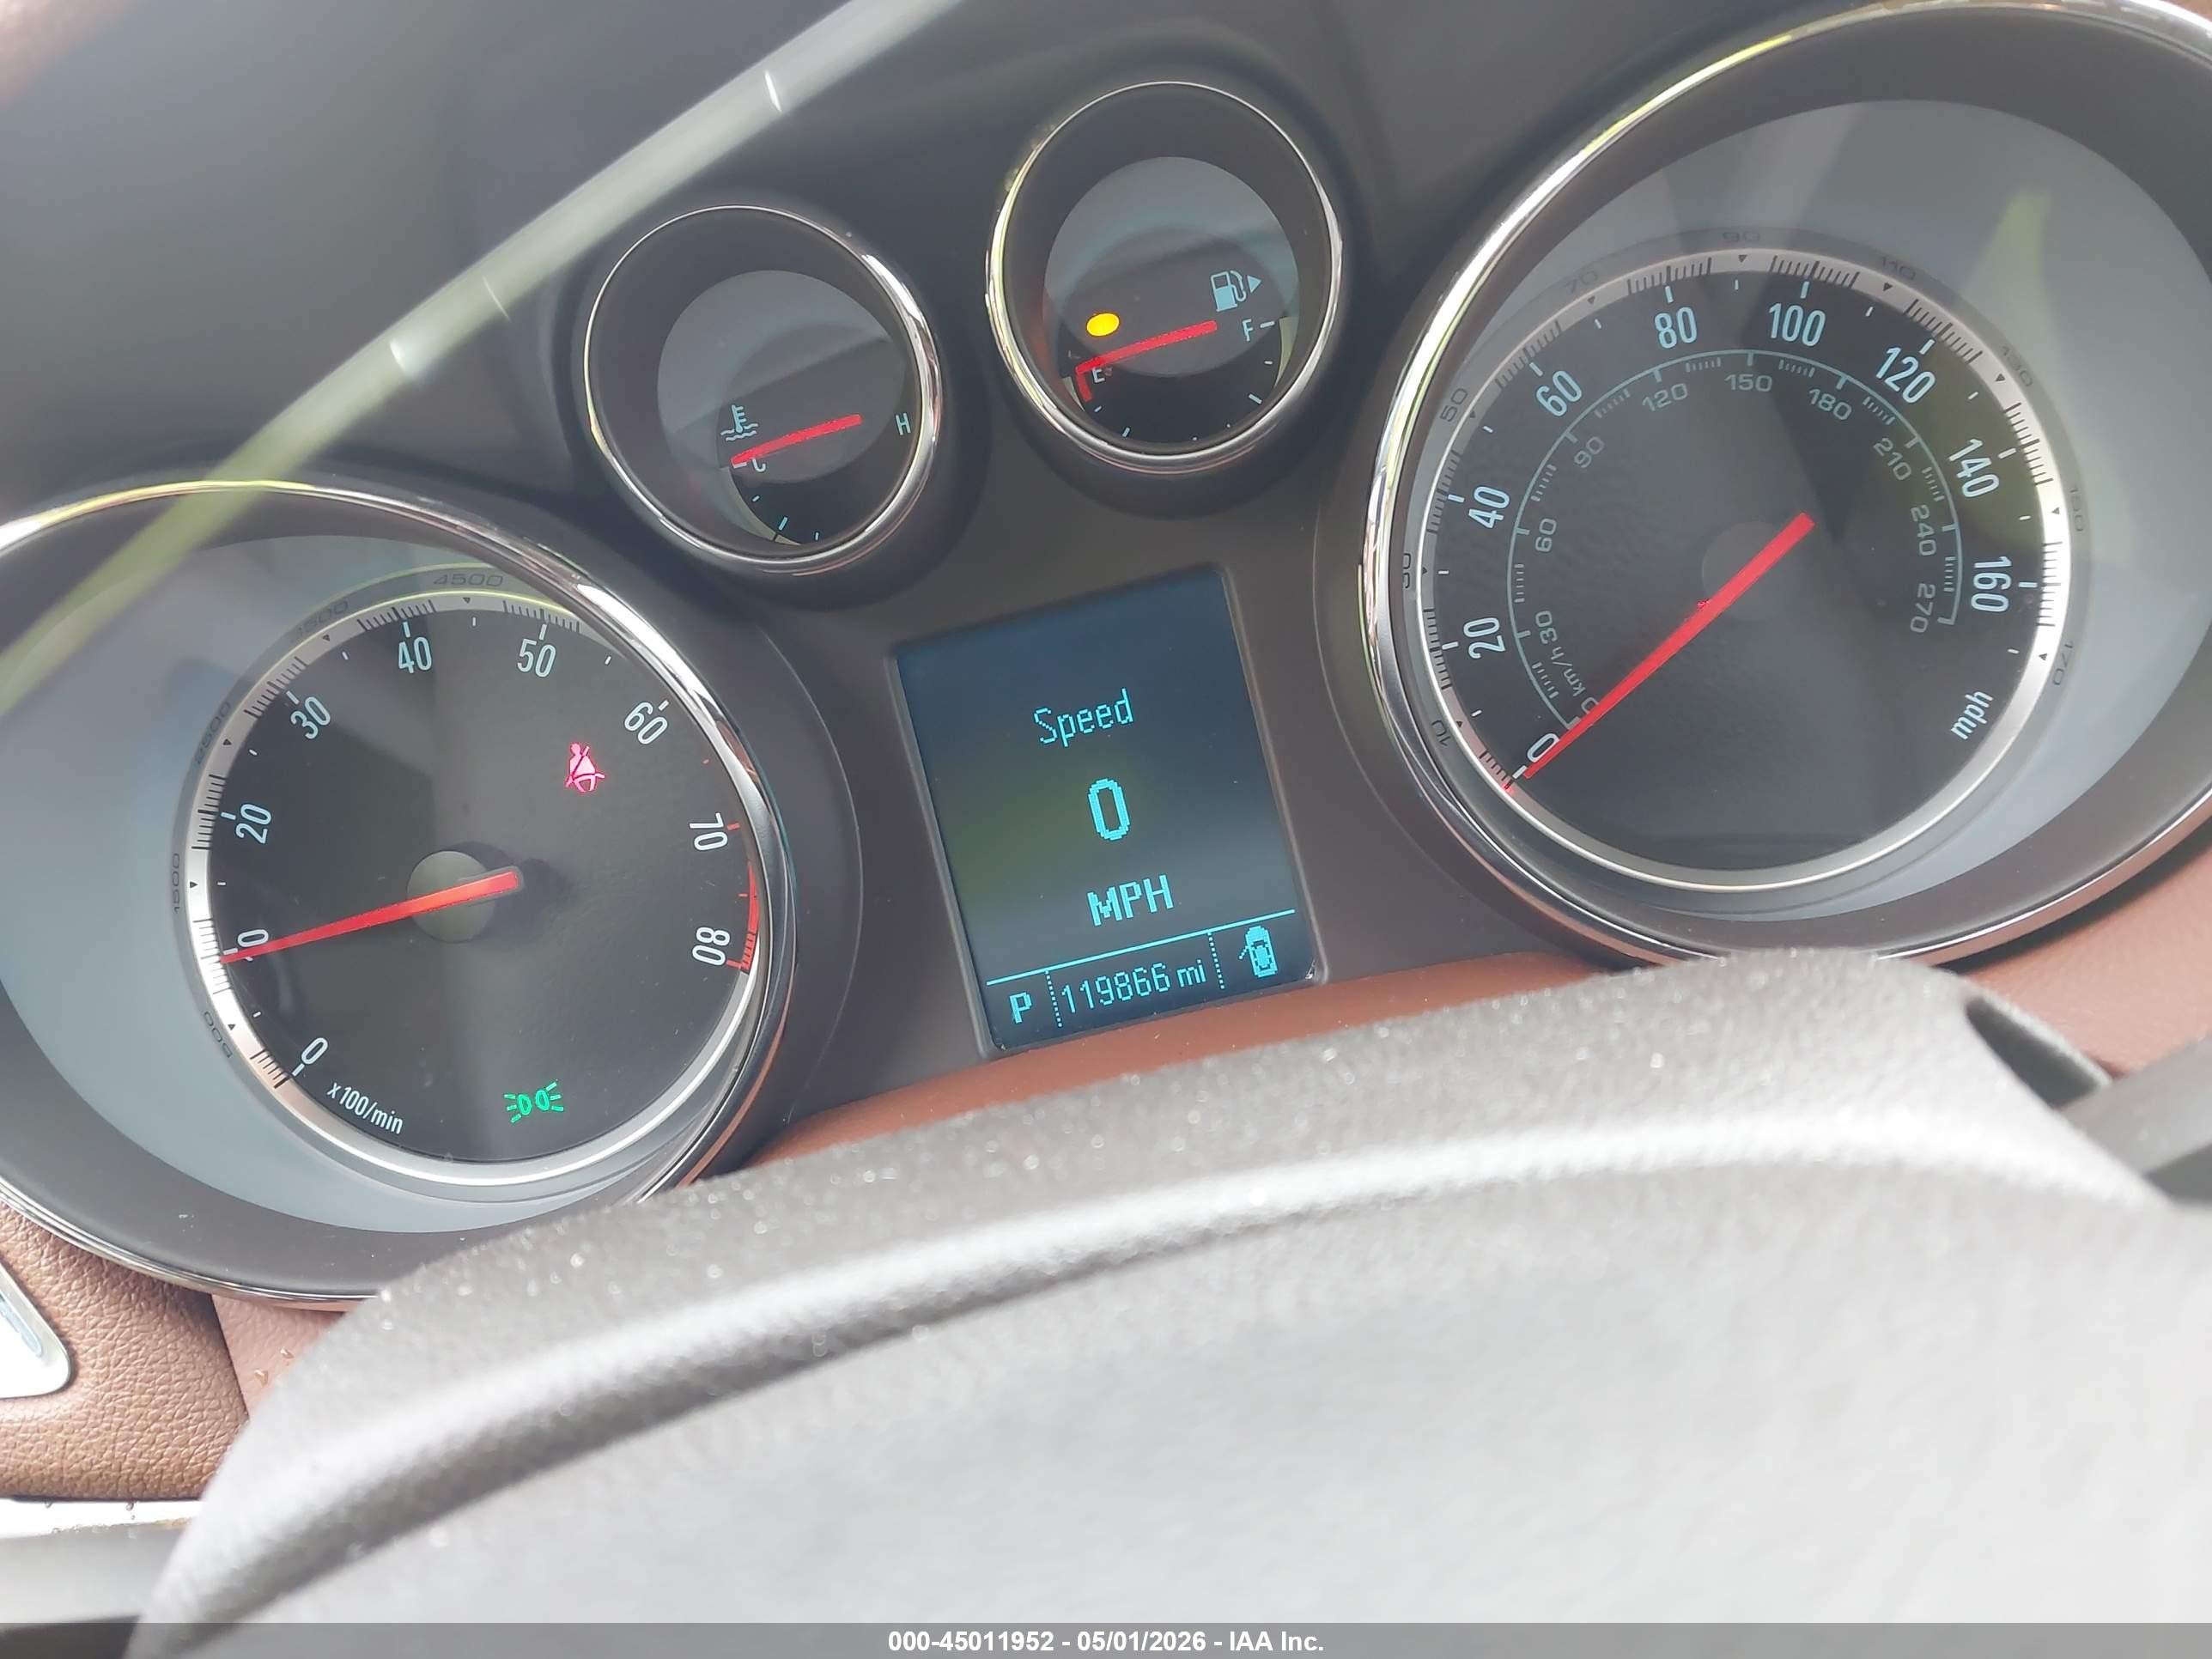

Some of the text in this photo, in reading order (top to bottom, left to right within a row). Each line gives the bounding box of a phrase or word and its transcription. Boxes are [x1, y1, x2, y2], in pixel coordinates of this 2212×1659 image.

[1242, 319, 1254, 341] F
[1654, 306, 1698, 349] 80
[1767, 302, 1826, 347] 100
[1535, 370, 1583, 417] 60
[1723, 374, 1773, 392] 150
[1875, 347, 1936, 404] 120
[1440, 387, 1468, 423] 50
[1642, 383, 1689, 412] 120
[1808, 388, 1853, 421] 180
[895, 412, 912, 435] H
[1573, 435, 1605, 468] 90
[1873, 437, 1912, 481] 210
[1948, 438, 2000, 498] 140
[1468, 485, 1510, 529] 40
[1534, 518, 1557, 553] 60
[1910, 504, 1937, 557] 240
[433, 573, 504, 587] 4500
[1970, 556, 2012, 613] 160
[1534, 611, 1558, 644] 30
[1909, 583, 1936, 634] 270
[398, 636, 432, 674] 40
[517, 639, 556, 678] 50
[1462, 617, 1506, 659] 20
[1550, 645, 1586, 697] km/h
[289, 696, 331, 740] 30
[623, 702, 669, 745] 60
[1032, 687, 1134, 748] Speed
[1950, 690, 1994, 740] mph
[1526, 732, 1560, 763] 0
[235, 804, 272, 844] 20
[1086, 777, 1132, 842] 0
[689, 812, 728, 851] 70
[1086, 874, 1176, 927] MPH
[691, 927, 731, 966] 80
[1060, 958, 1206, 1014] 119866 mi
[1008, 991, 1032, 1024] P
[301, 1036, 329, 1066] 0
